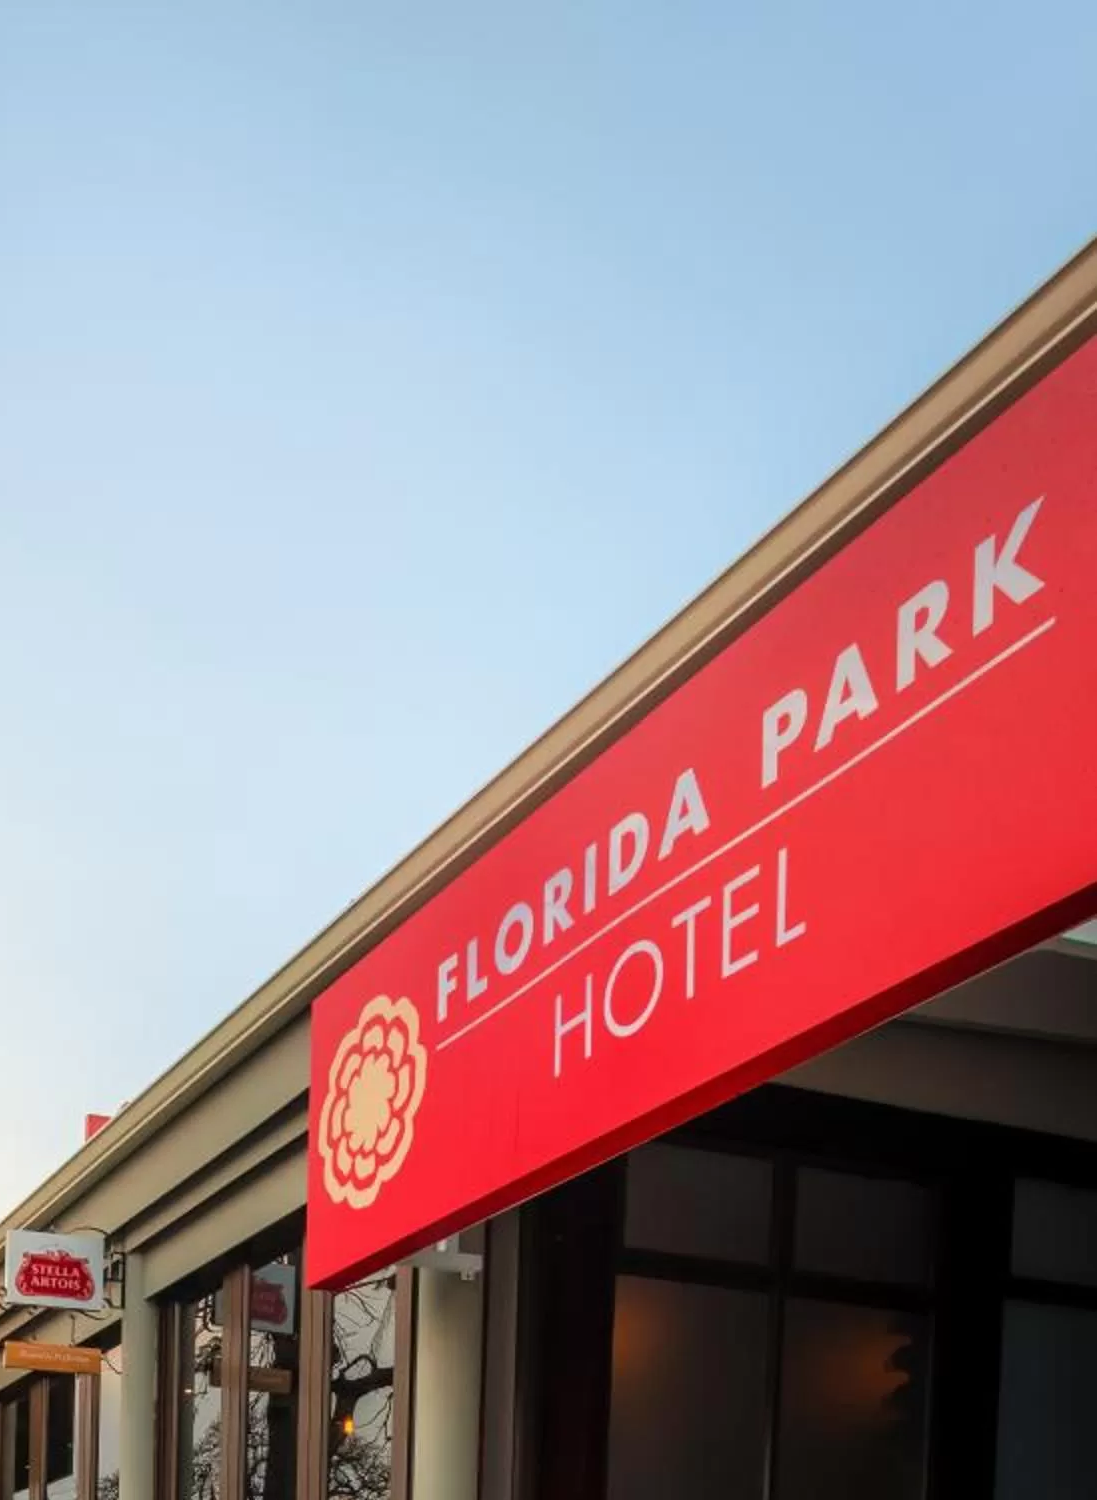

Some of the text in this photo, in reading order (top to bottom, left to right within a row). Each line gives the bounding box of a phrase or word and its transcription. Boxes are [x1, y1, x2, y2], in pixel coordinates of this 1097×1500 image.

[436, 494, 1046, 1023] FLORIDA PARK
[553, 847, 807, 1077] HOTEL
[30, 1264, 80, 1278] STELLA
[30, 1276, 81, 1290] ARTOIS
